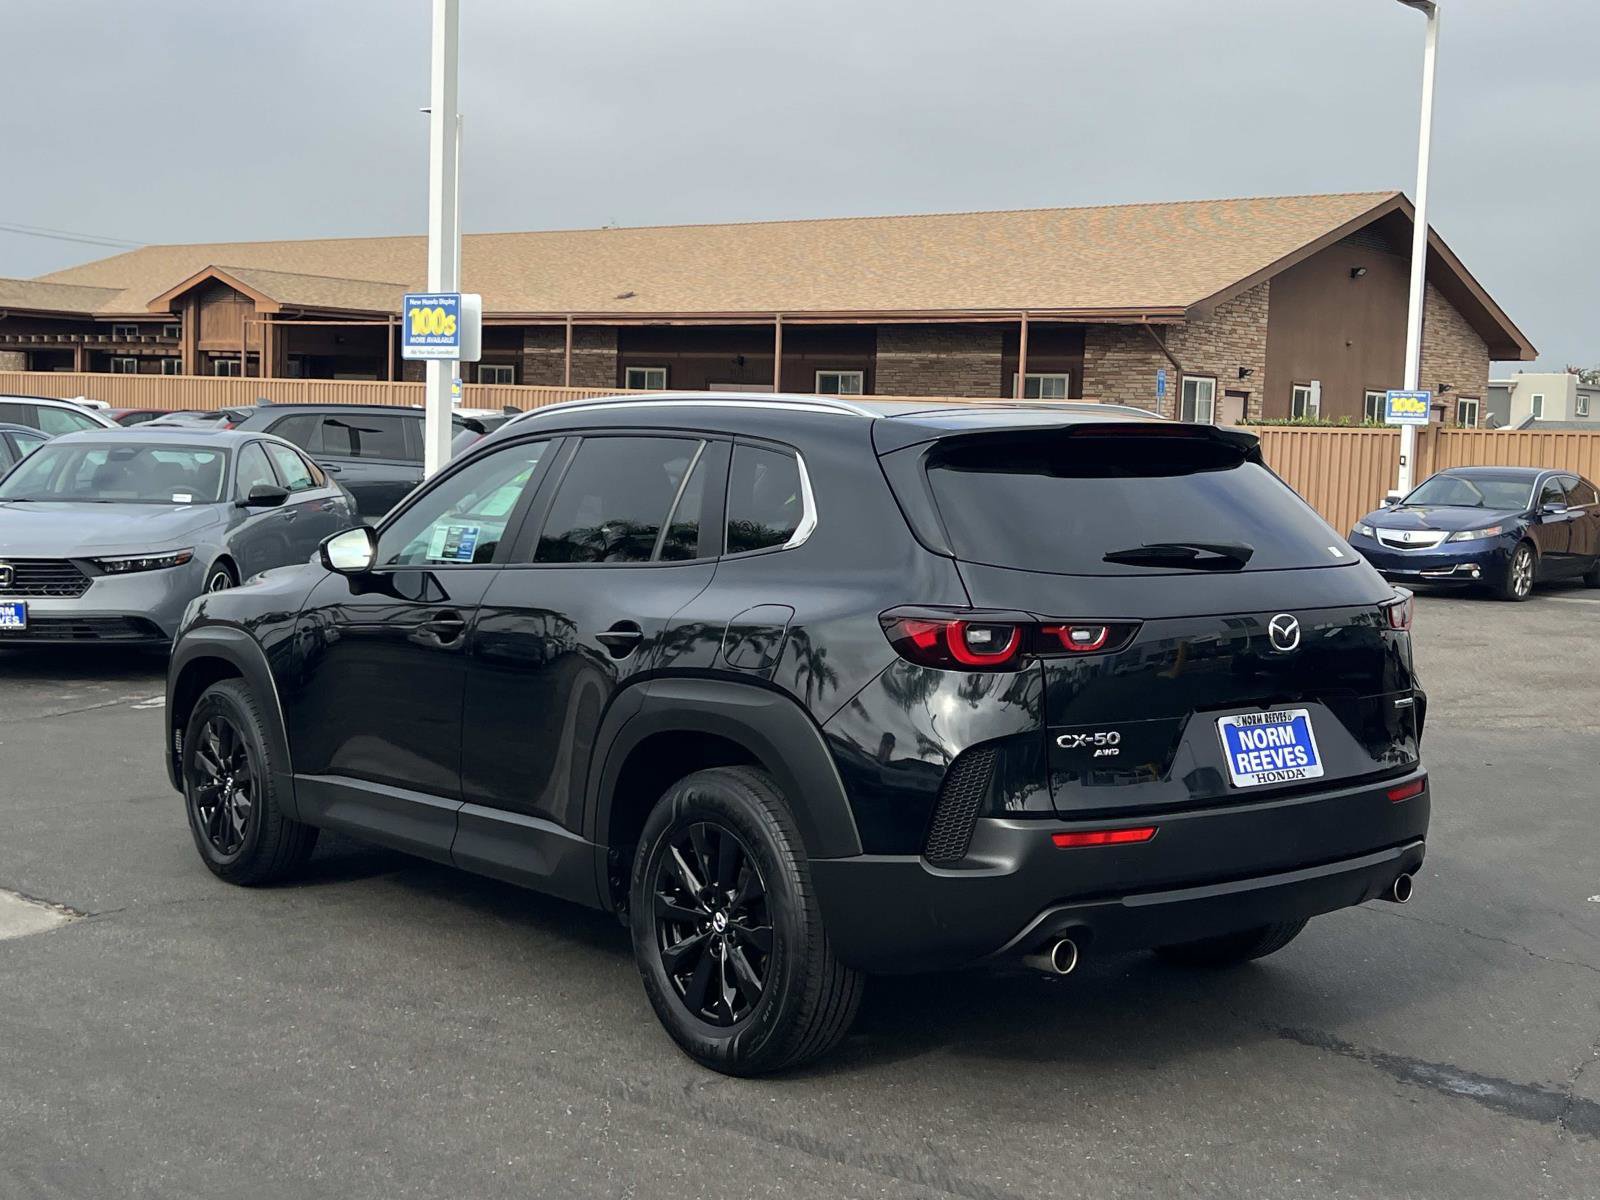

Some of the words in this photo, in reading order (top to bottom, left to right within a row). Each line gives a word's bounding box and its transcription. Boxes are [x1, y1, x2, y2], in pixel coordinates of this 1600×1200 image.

[408, 307, 456, 336] 100s
[1390, 397, 1426, 413] 100s
[1242, 714, 1263, 726] NORM
[1264, 712, 1287, 723] REEVES
[1056, 731, 1121, 748] CX-50
[1238, 725, 1296, 750] NORM
[1093, 748, 1120, 757] AWD
[1236, 745, 1308, 773] REEVES
[1256, 769, 1305, 783] HONDA
